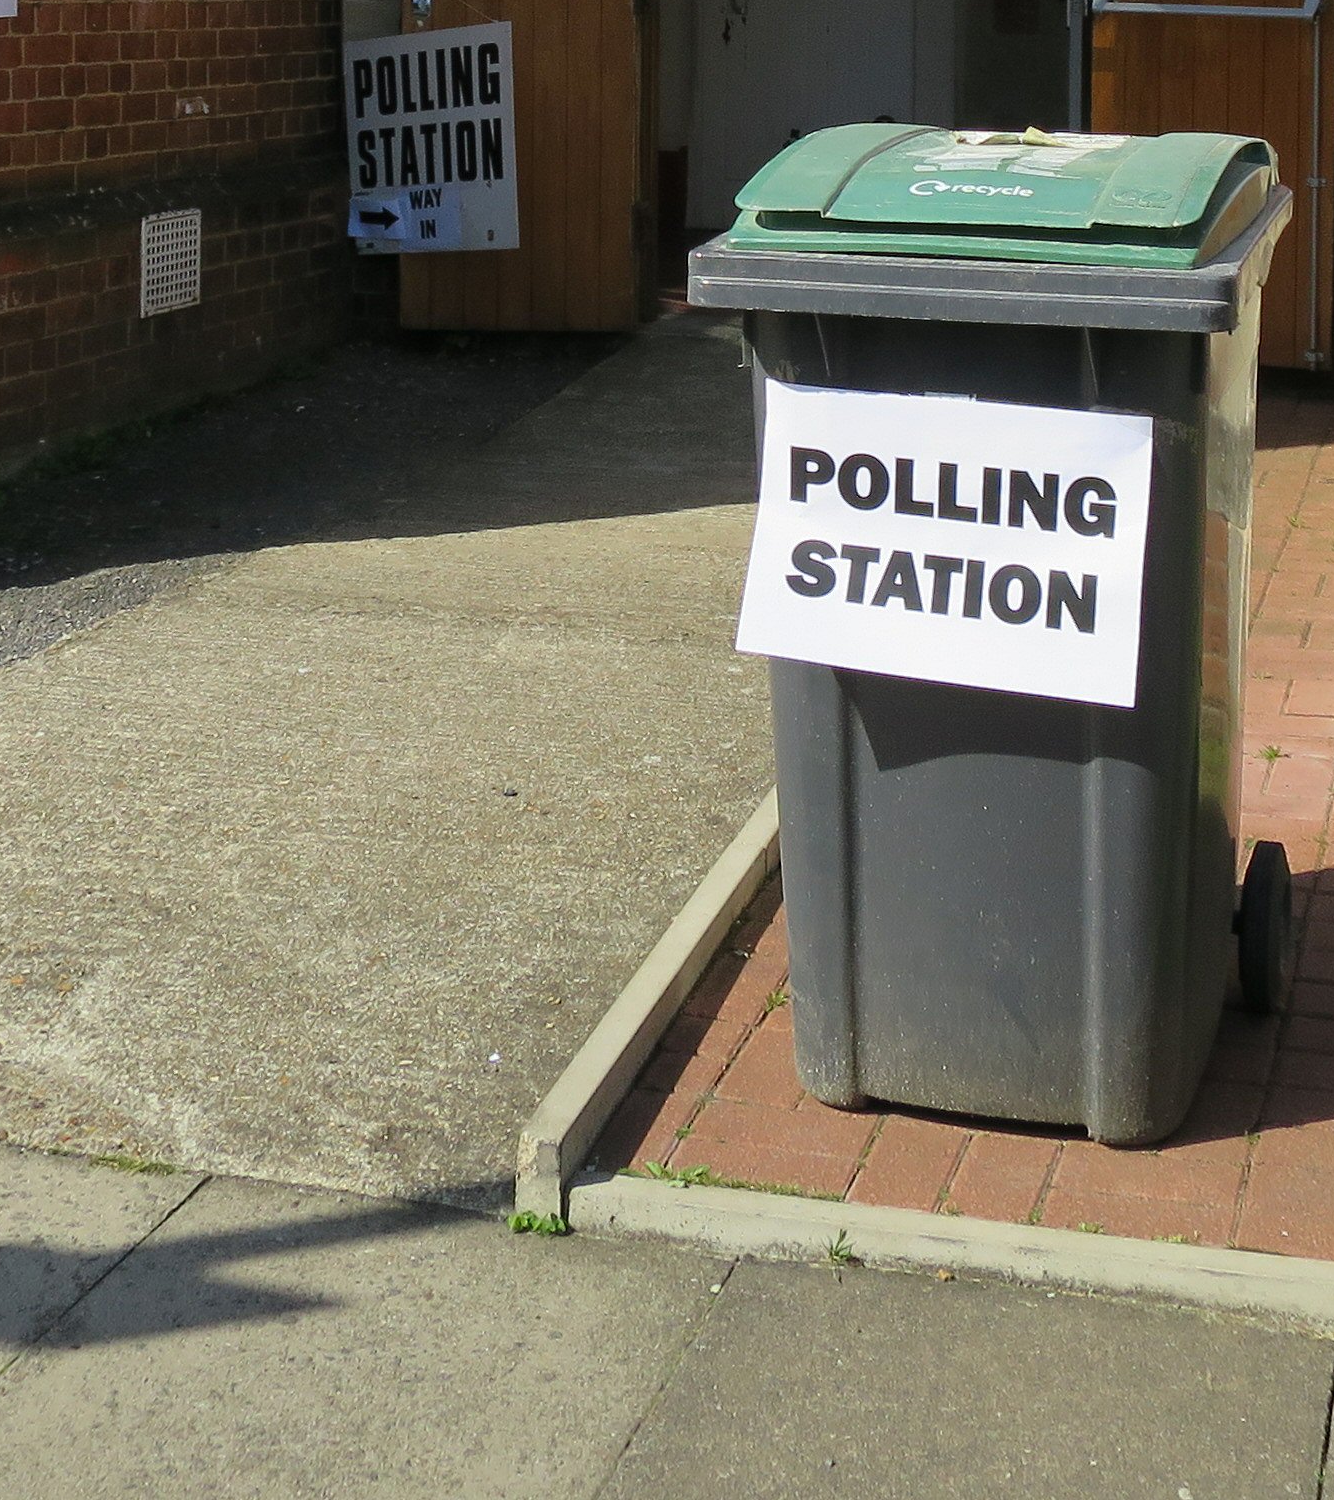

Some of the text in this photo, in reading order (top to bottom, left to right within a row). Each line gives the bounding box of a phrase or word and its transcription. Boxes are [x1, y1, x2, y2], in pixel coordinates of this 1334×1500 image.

[352, 42, 501, 119] POLLING
[357, 118, 504, 189] STATION
[409, 188, 442, 210] WAY
[950, 183, 1034, 198] recycle
[419, 219, 437, 239] IN
[789, 444, 1118, 539] POLLING
[785, 539, 1099, 635] STATION
